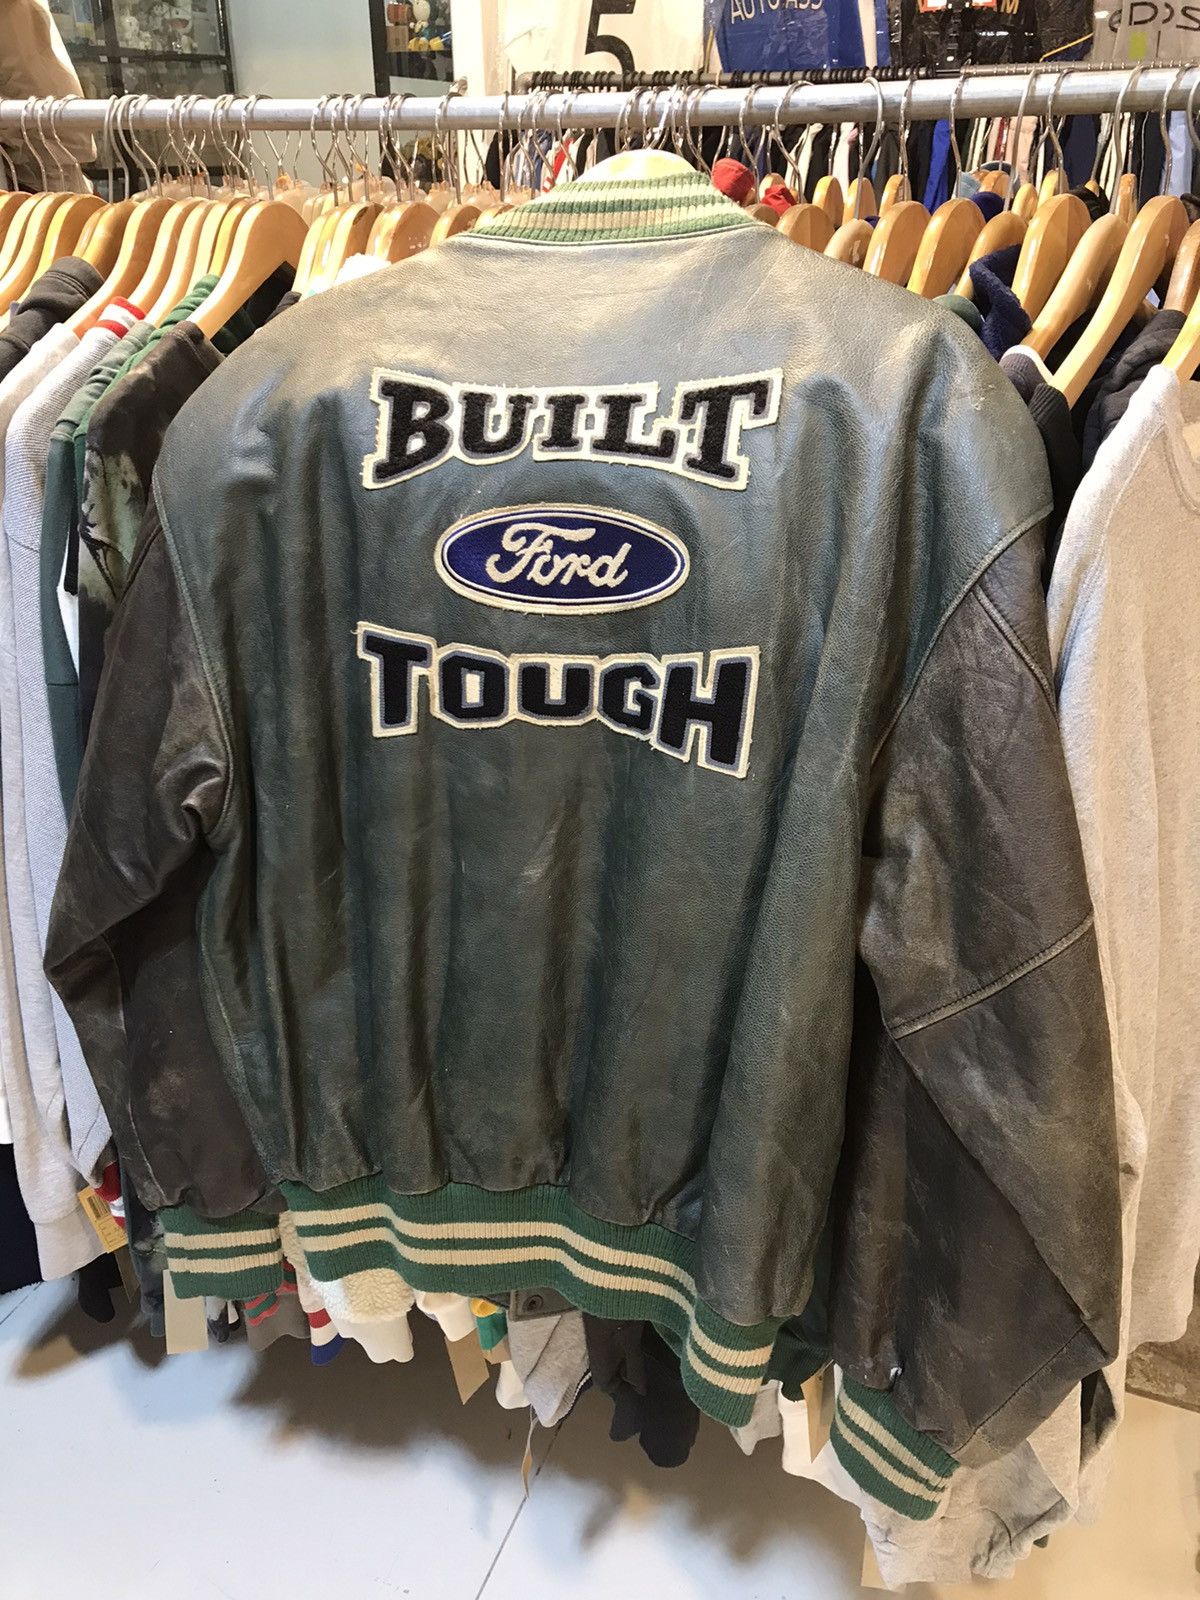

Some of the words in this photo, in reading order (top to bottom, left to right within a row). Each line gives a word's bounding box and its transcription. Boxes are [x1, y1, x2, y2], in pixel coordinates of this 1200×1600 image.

[370, 374, 778, 485] BUILT
[485, 522, 632, 588] Ford
[361, 628, 753, 773] TOUGH
